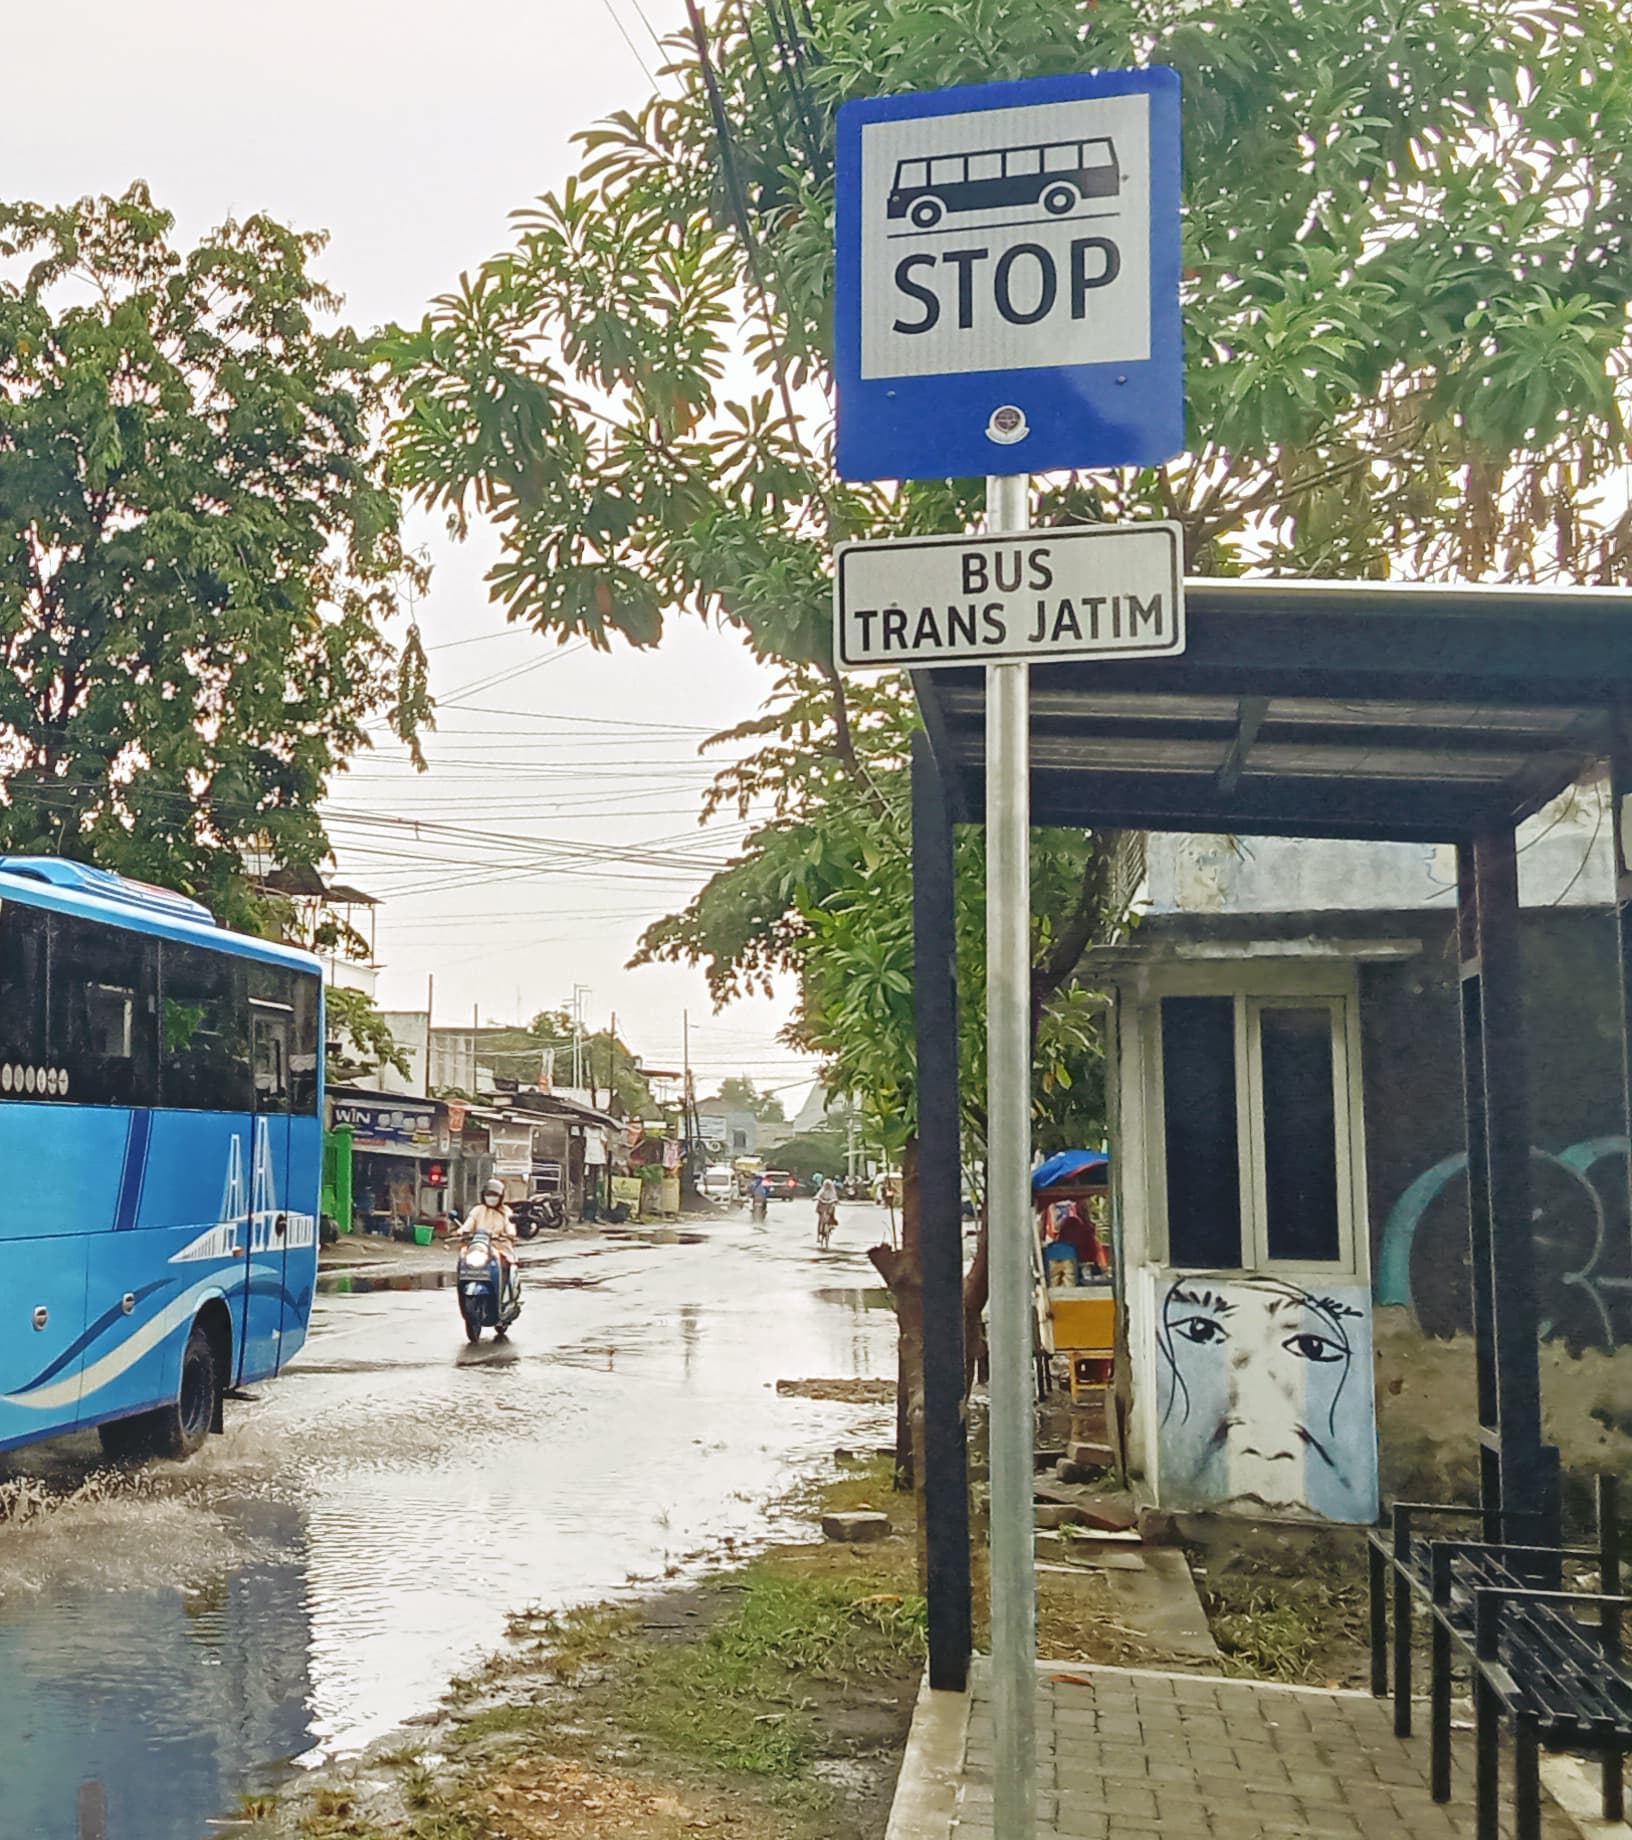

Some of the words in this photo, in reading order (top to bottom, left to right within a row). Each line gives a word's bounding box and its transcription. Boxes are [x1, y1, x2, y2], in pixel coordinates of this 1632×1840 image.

[893, 237, 1121, 334] STOP
[962, 548, 1053, 594] BUS
[854, 603, 1006, 650] TRANS
[1028, 594, 1163, 642] JATIM
